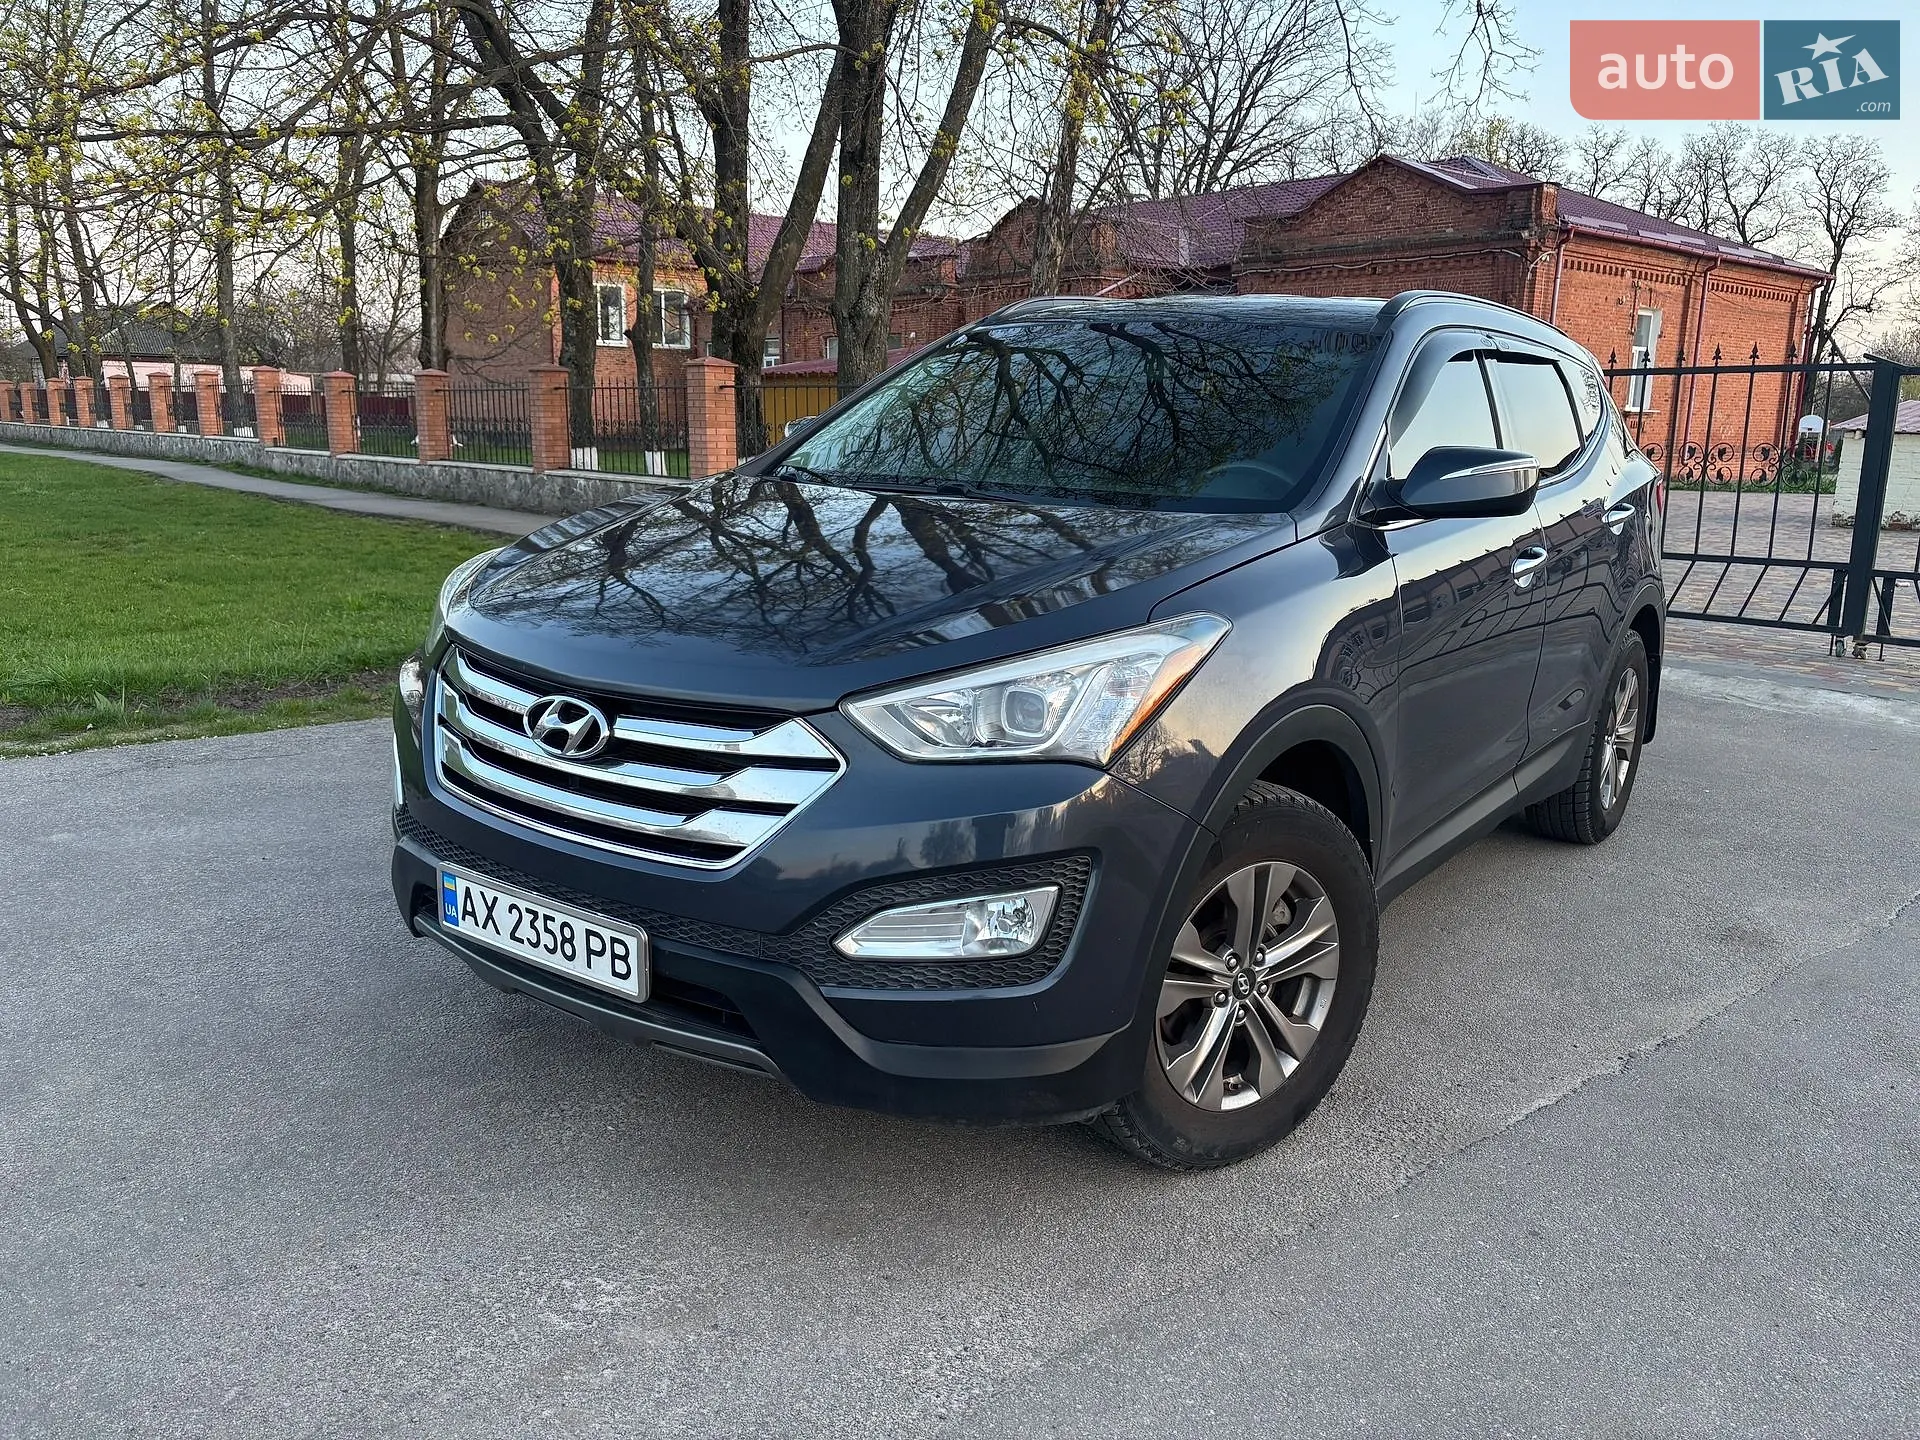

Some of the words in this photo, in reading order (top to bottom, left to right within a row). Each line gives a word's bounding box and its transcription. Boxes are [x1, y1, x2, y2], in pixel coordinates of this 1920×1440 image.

[445, 903, 458, 919] UA
[461, 886, 501, 935] AX
[508, 903, 576, 962] 2358
[584, 928, 632, 980] PB
